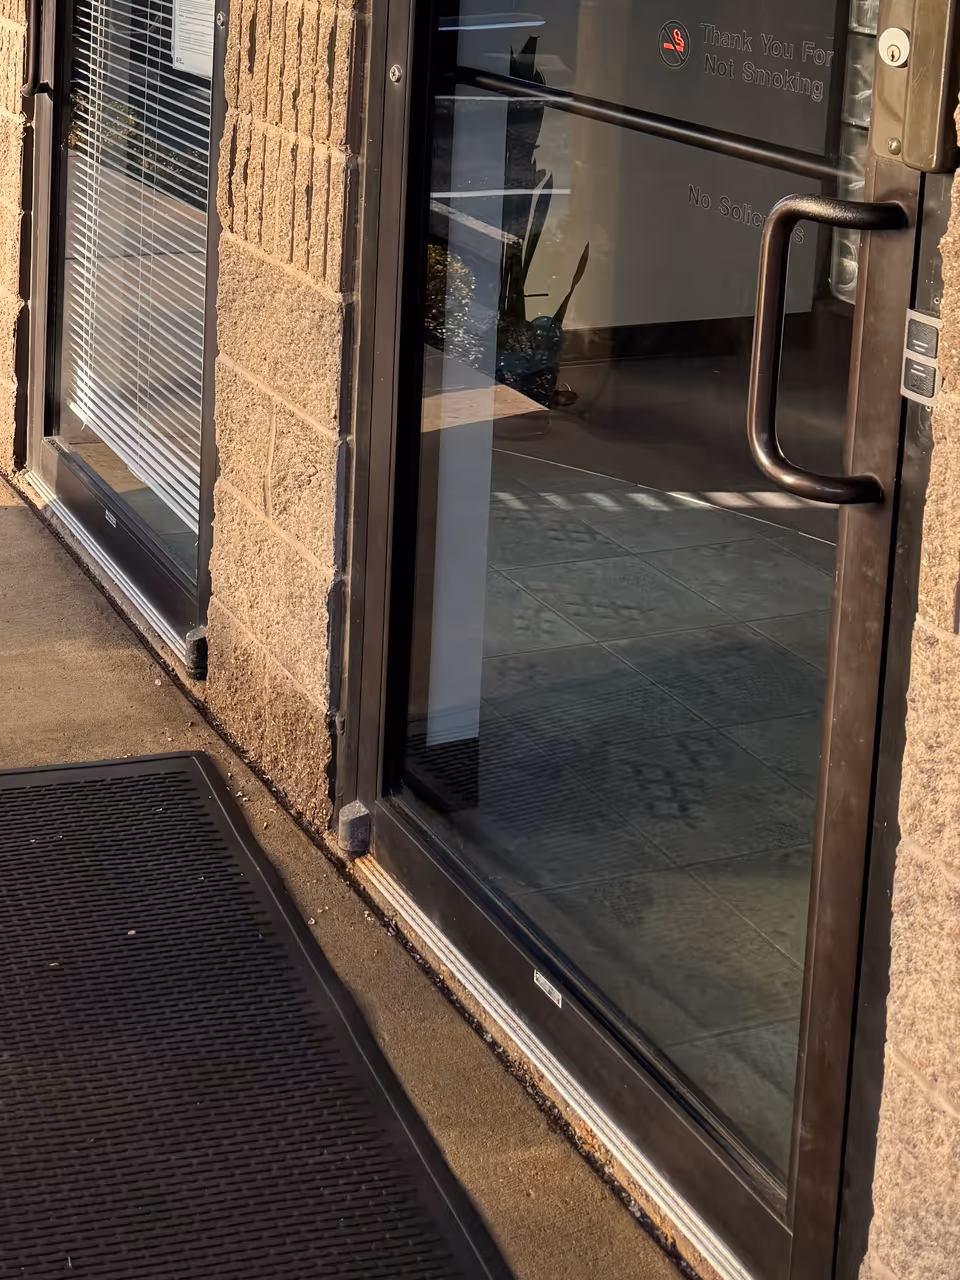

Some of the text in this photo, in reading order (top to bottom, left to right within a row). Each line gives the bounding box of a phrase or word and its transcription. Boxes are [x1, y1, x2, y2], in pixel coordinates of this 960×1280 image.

[700, 22, 834, 67] Thank You For
[704, 53, 824, 102] Not Smoking
[688, 184, 805, 244] No Solics
